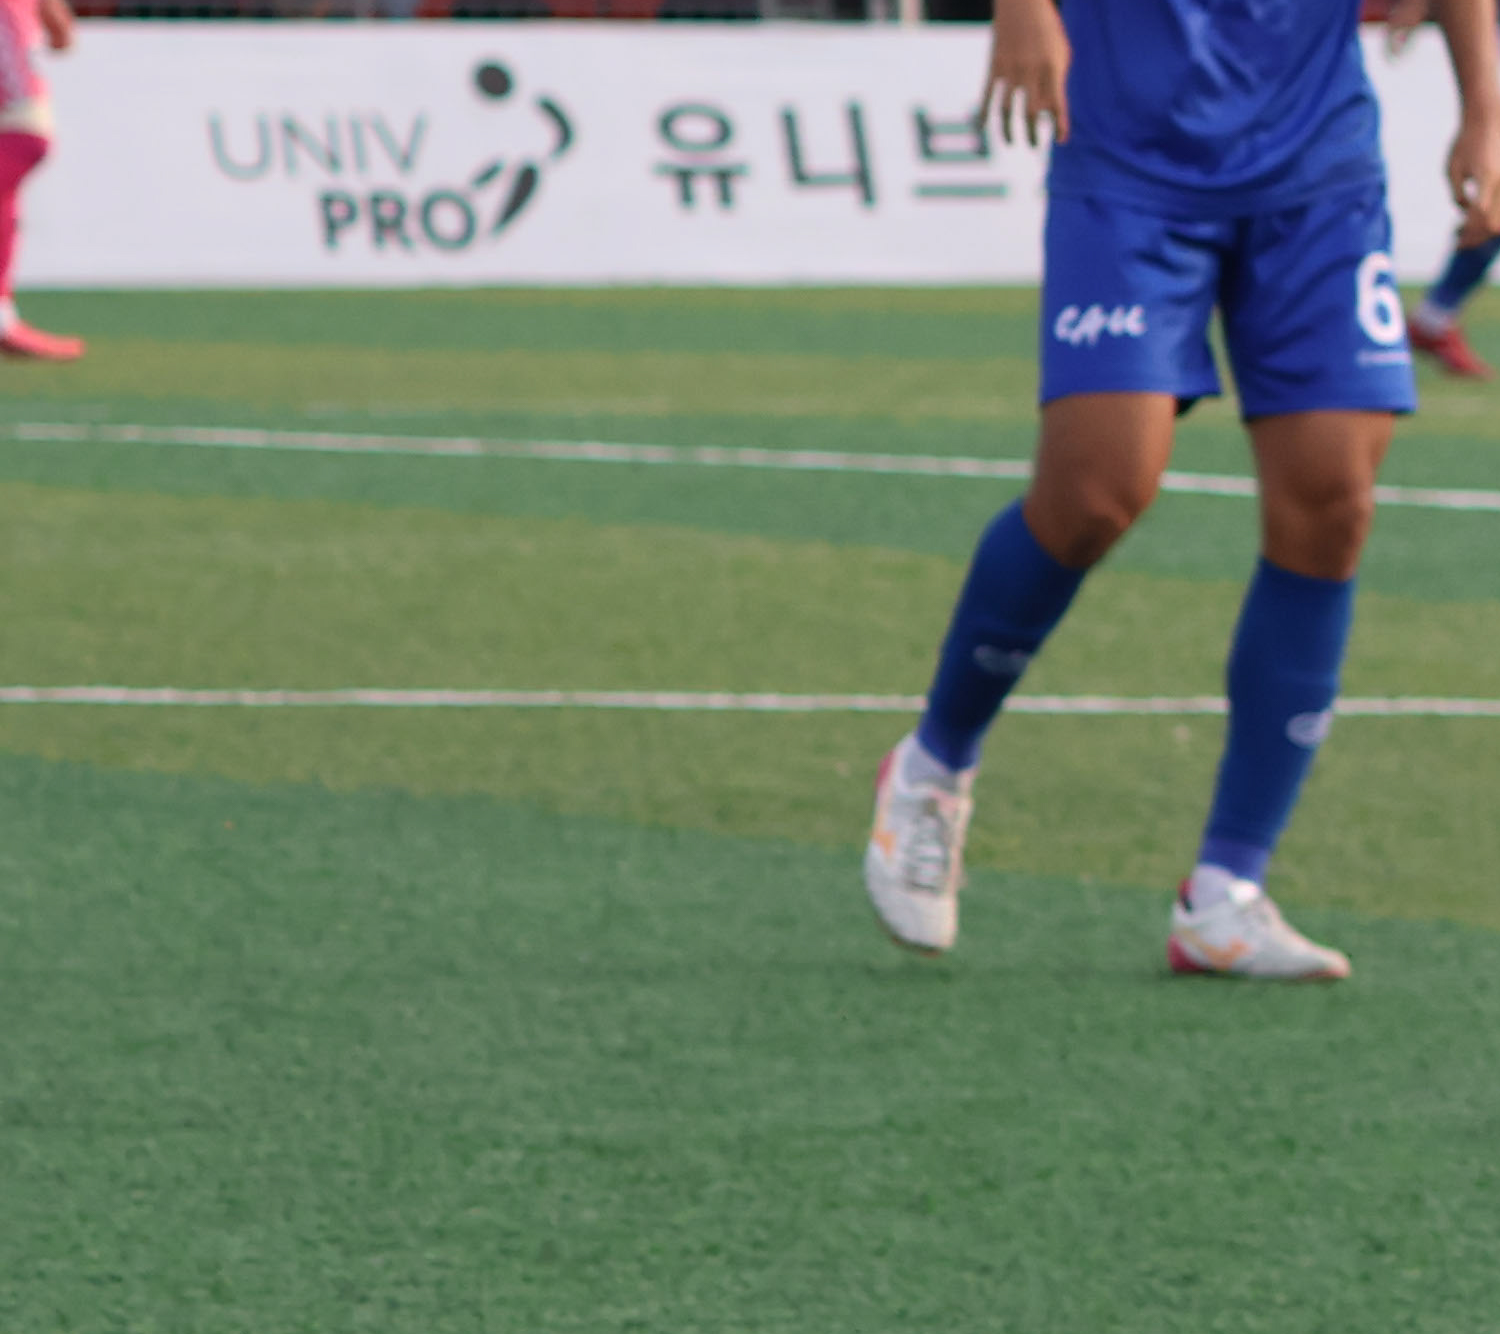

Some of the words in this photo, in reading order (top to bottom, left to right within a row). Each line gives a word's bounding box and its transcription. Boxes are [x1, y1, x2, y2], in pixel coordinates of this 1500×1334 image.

[206, 110, 429, 183] UNIV
[652, 99, 1045, 214] 유니브
[317, 187, 479, 253] PRO
[1356, 253, 1407, 348] 6
